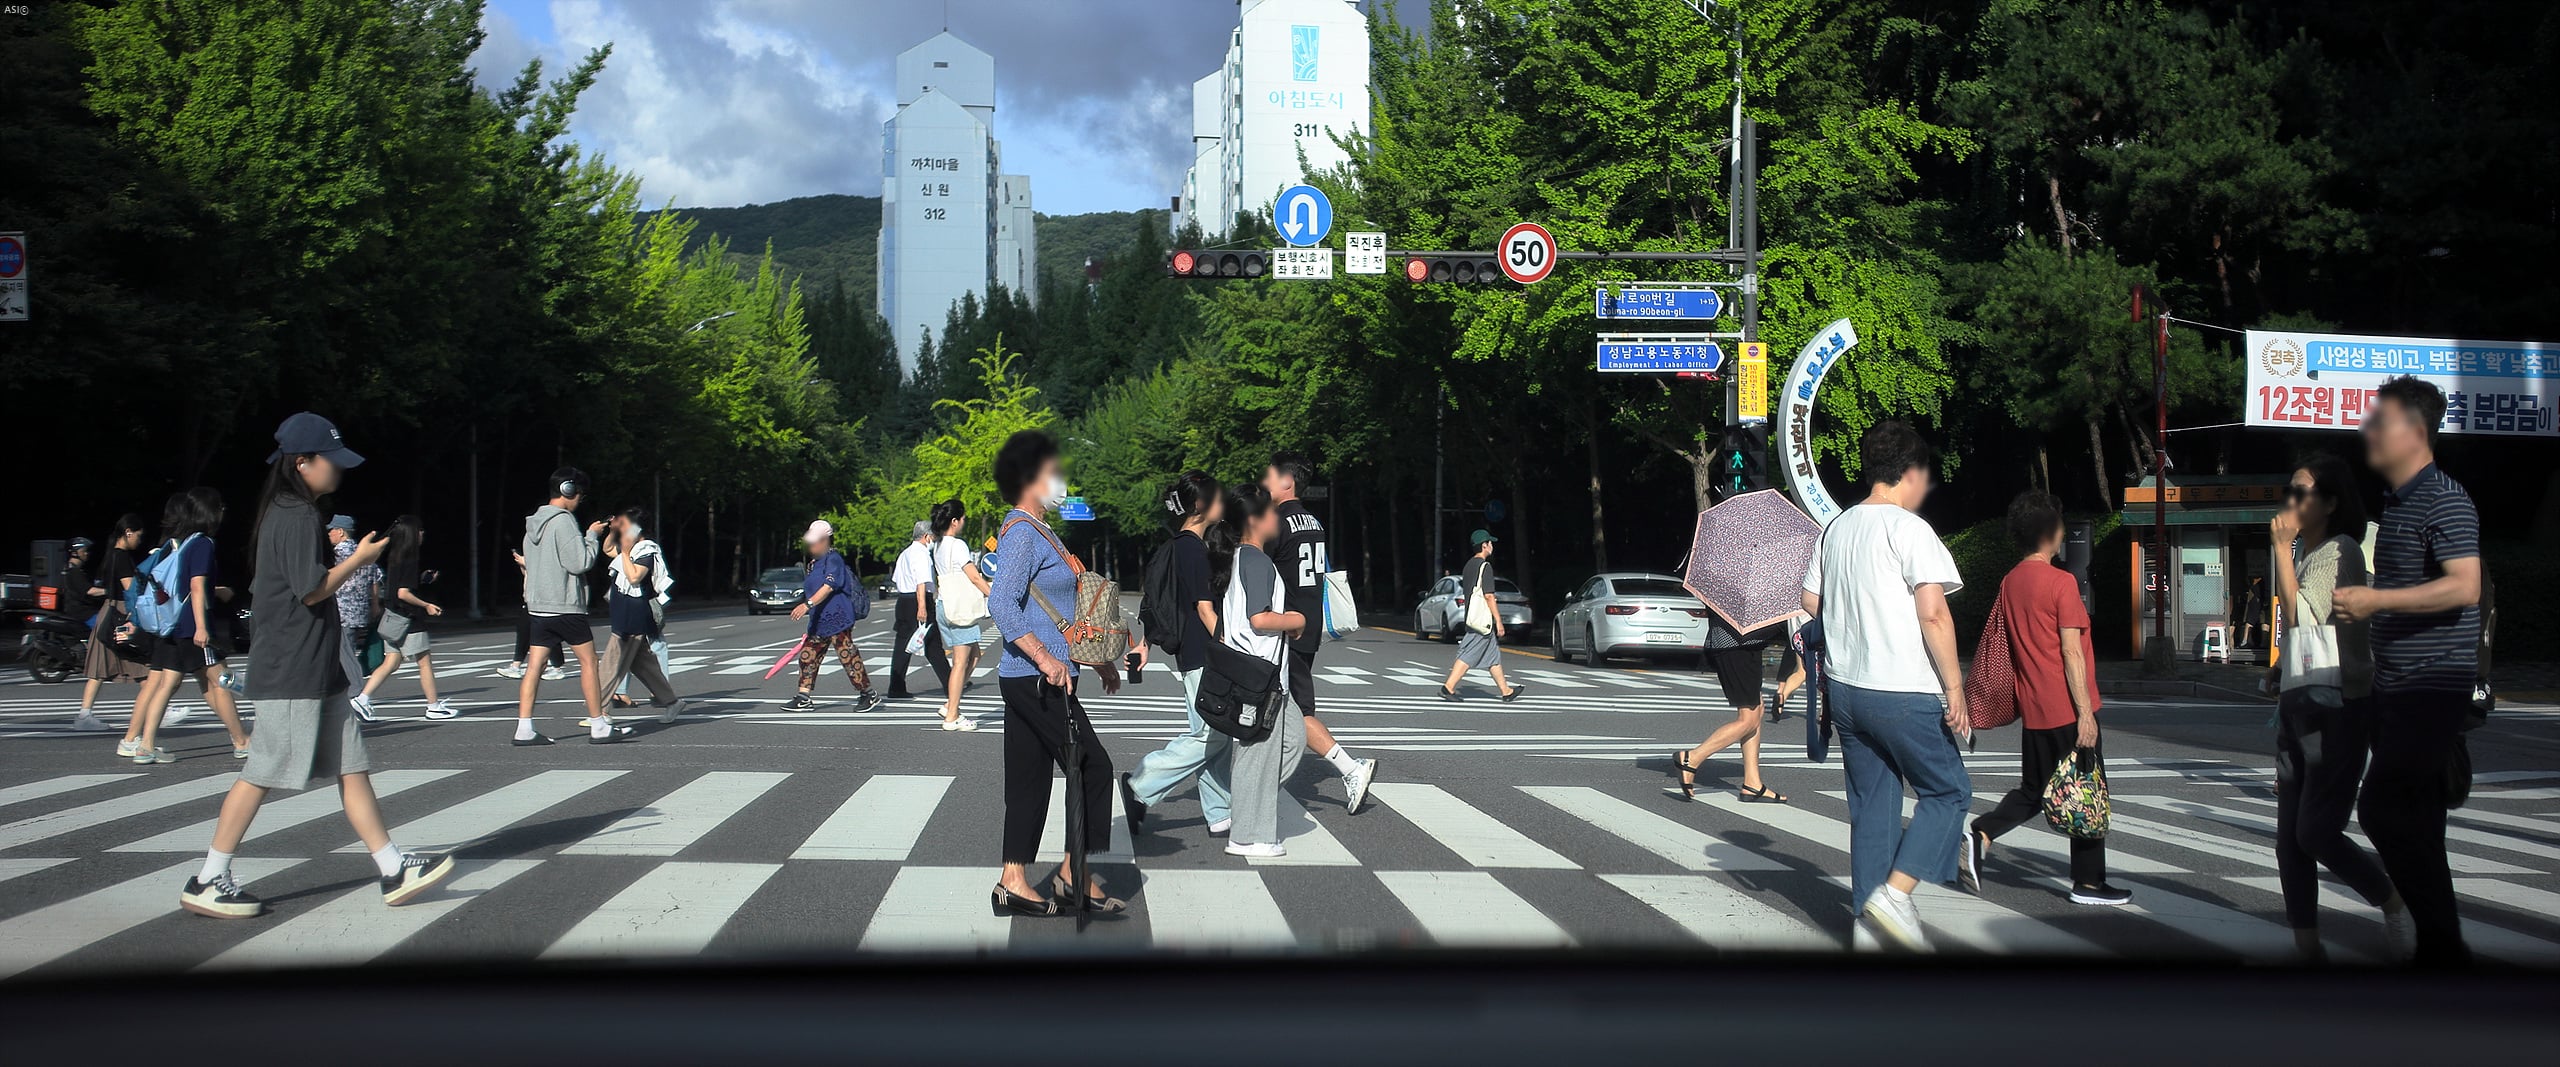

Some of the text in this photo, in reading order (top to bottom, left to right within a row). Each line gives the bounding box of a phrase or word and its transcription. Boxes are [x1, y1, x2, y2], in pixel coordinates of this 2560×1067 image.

[1269, 90, 1343, 110] 아침도시
[1293, 123, 1317, 137] 311
[911, 157, 959, 171] 까치마을
[924, 208, 946, 220] 312
[1511, 240, 1544, 267] 50
[1640, 307, 1685, 317] 90beon-gil
[1609, 346, 1707, 359] 성남고용노동지청
[2270, 349, 2296, 366] 경축
[2317, 345, 2367, 369] 사업성
[2371, 347, 2425, 372] 높이고,
[2429, 350, 2478, 372] 부담은
[1608, 361, 1651, 369] Employment
[1798, 332, 1846, 401] 까치마을
[2259, 385, 2335, 425] 12조원
[2474, 392, 2552, 432] 분담금이
[1806, 482, 1832, 516] 성남시
[1299, 542, 1326, 587] 24
